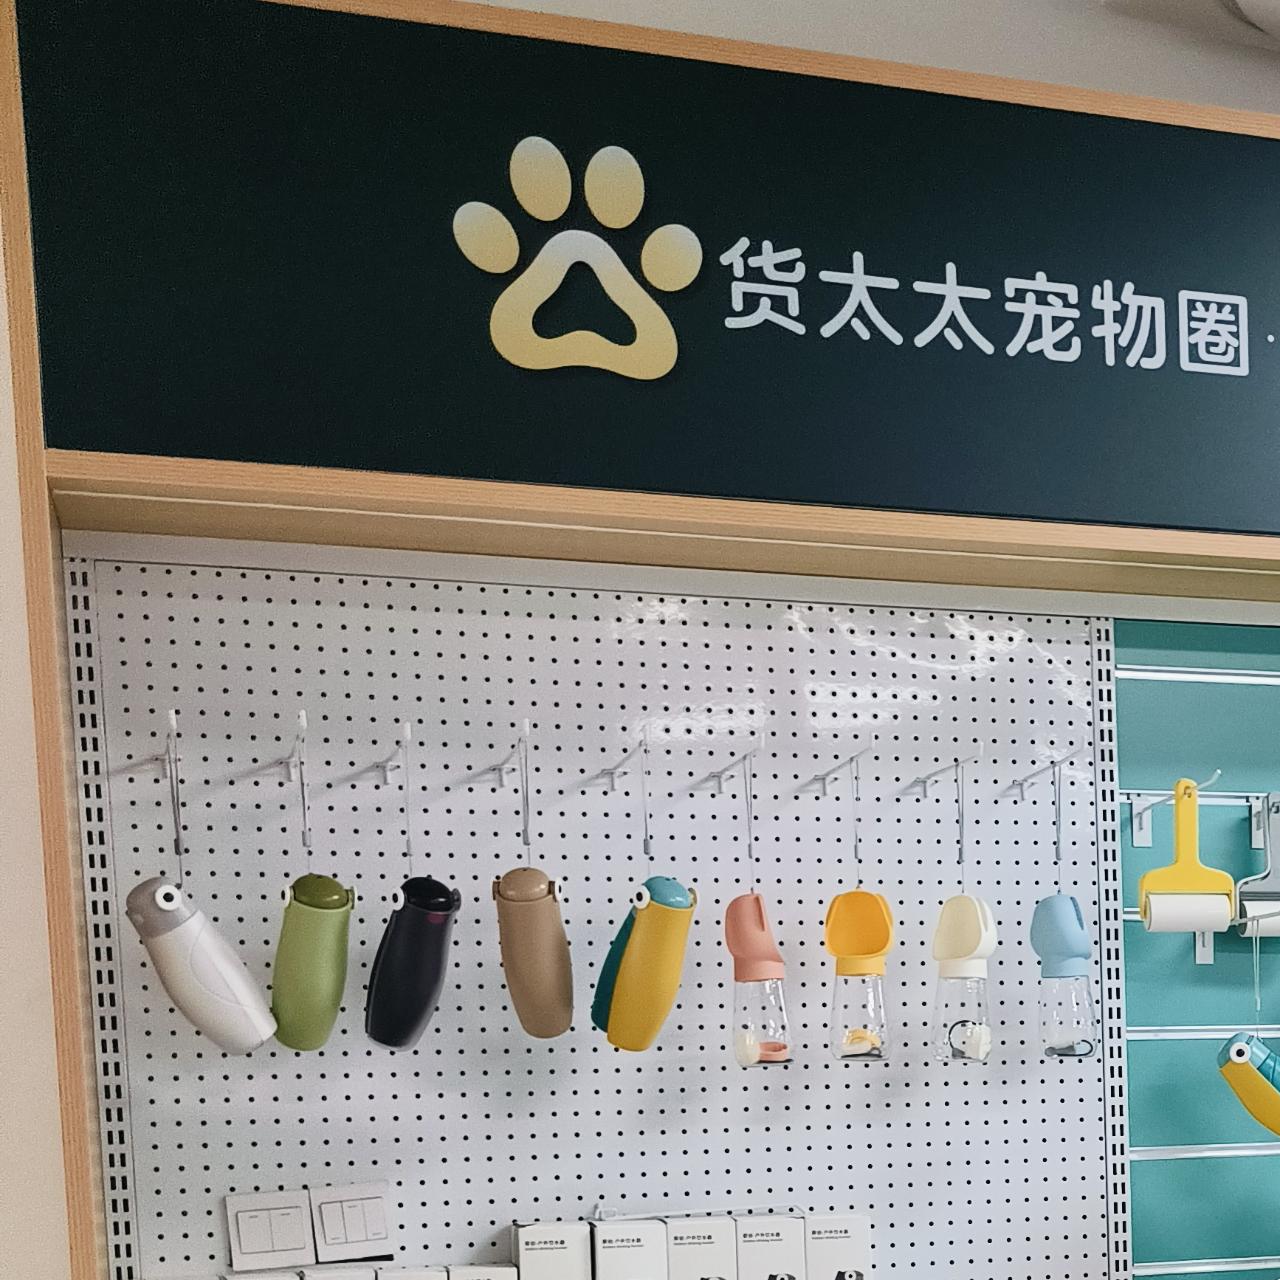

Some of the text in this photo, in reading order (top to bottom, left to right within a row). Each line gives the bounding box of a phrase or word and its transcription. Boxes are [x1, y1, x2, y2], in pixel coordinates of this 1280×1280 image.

[720, 236, 1250, 377] 货太太宠物圈
